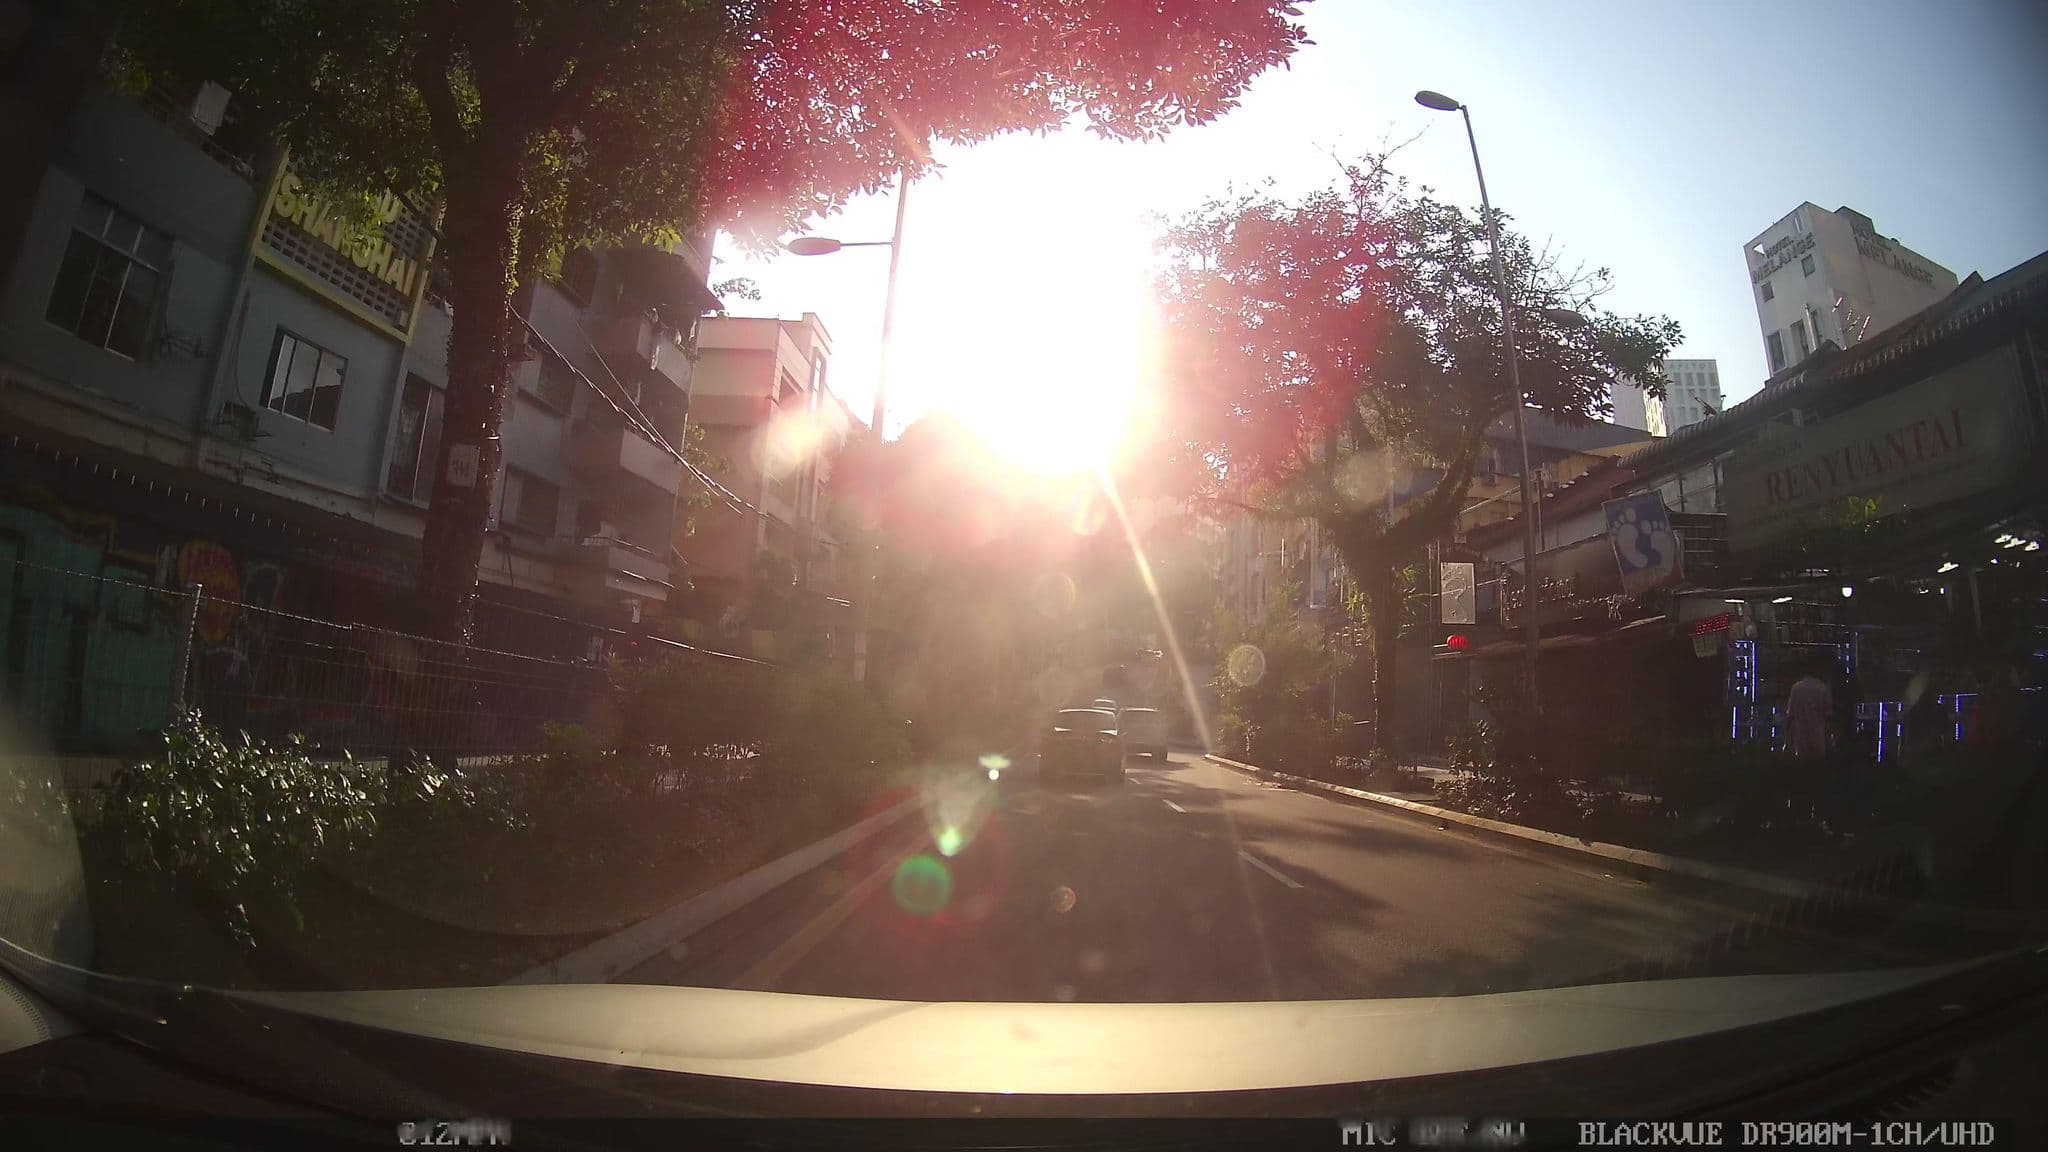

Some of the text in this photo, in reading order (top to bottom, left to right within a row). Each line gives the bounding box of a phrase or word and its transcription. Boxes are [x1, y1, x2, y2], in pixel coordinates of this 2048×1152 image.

[1752, 232, 1816, 285] MELANGE
[1766, 235, 1795, 259] HOTEL
[1766, 407, 1968, 506] RENYUANTAI
